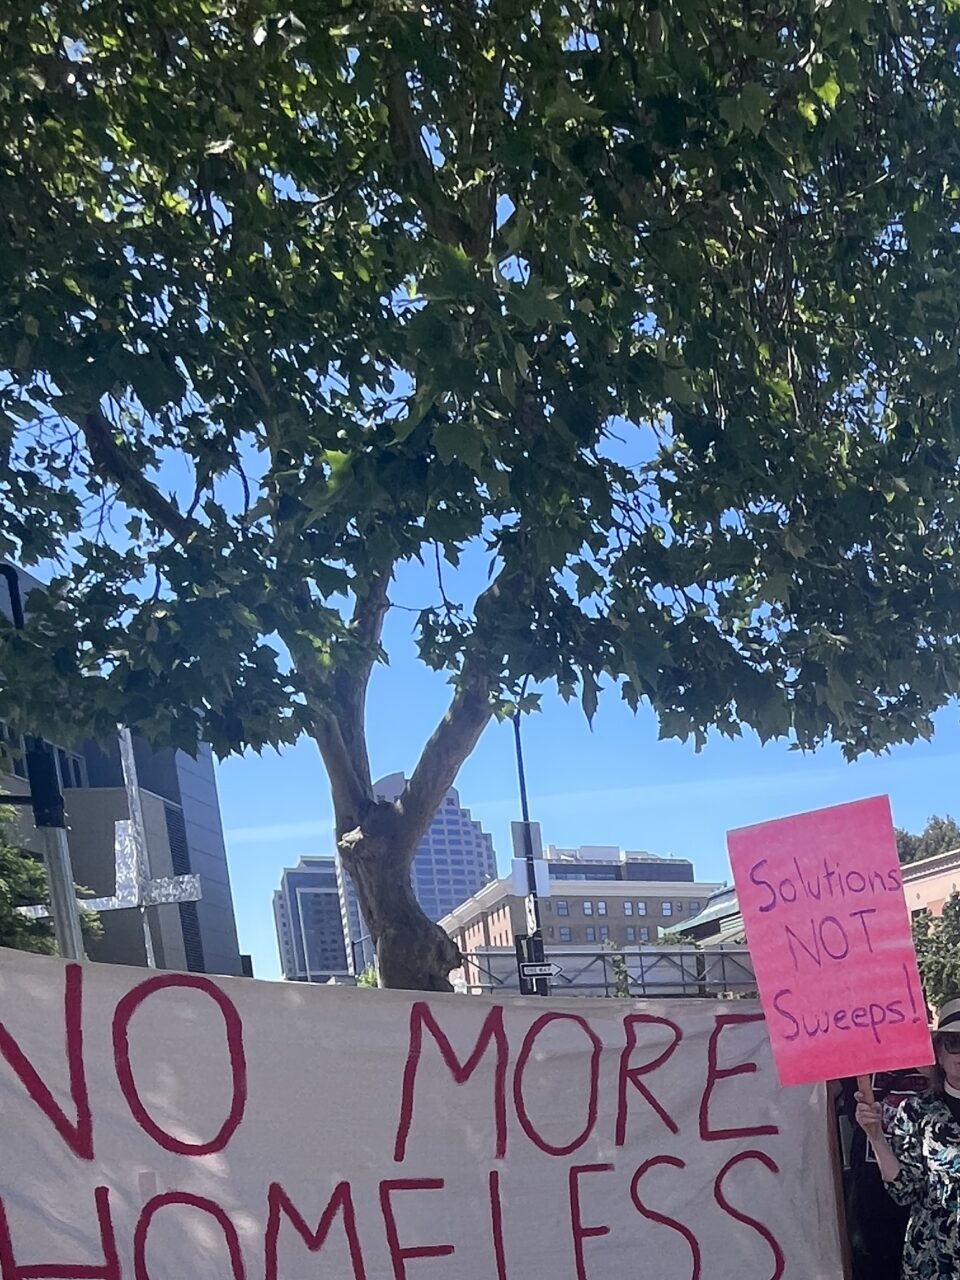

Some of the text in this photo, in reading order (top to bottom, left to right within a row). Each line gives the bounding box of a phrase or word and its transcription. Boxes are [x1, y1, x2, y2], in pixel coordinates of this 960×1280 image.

[750, 857, 901, 913] Solutions
[785, 908, 878, 969] NOT
[773, 966, 922, 1044] Sweeps!
[0, 963, 780, 1162] NO MORE
